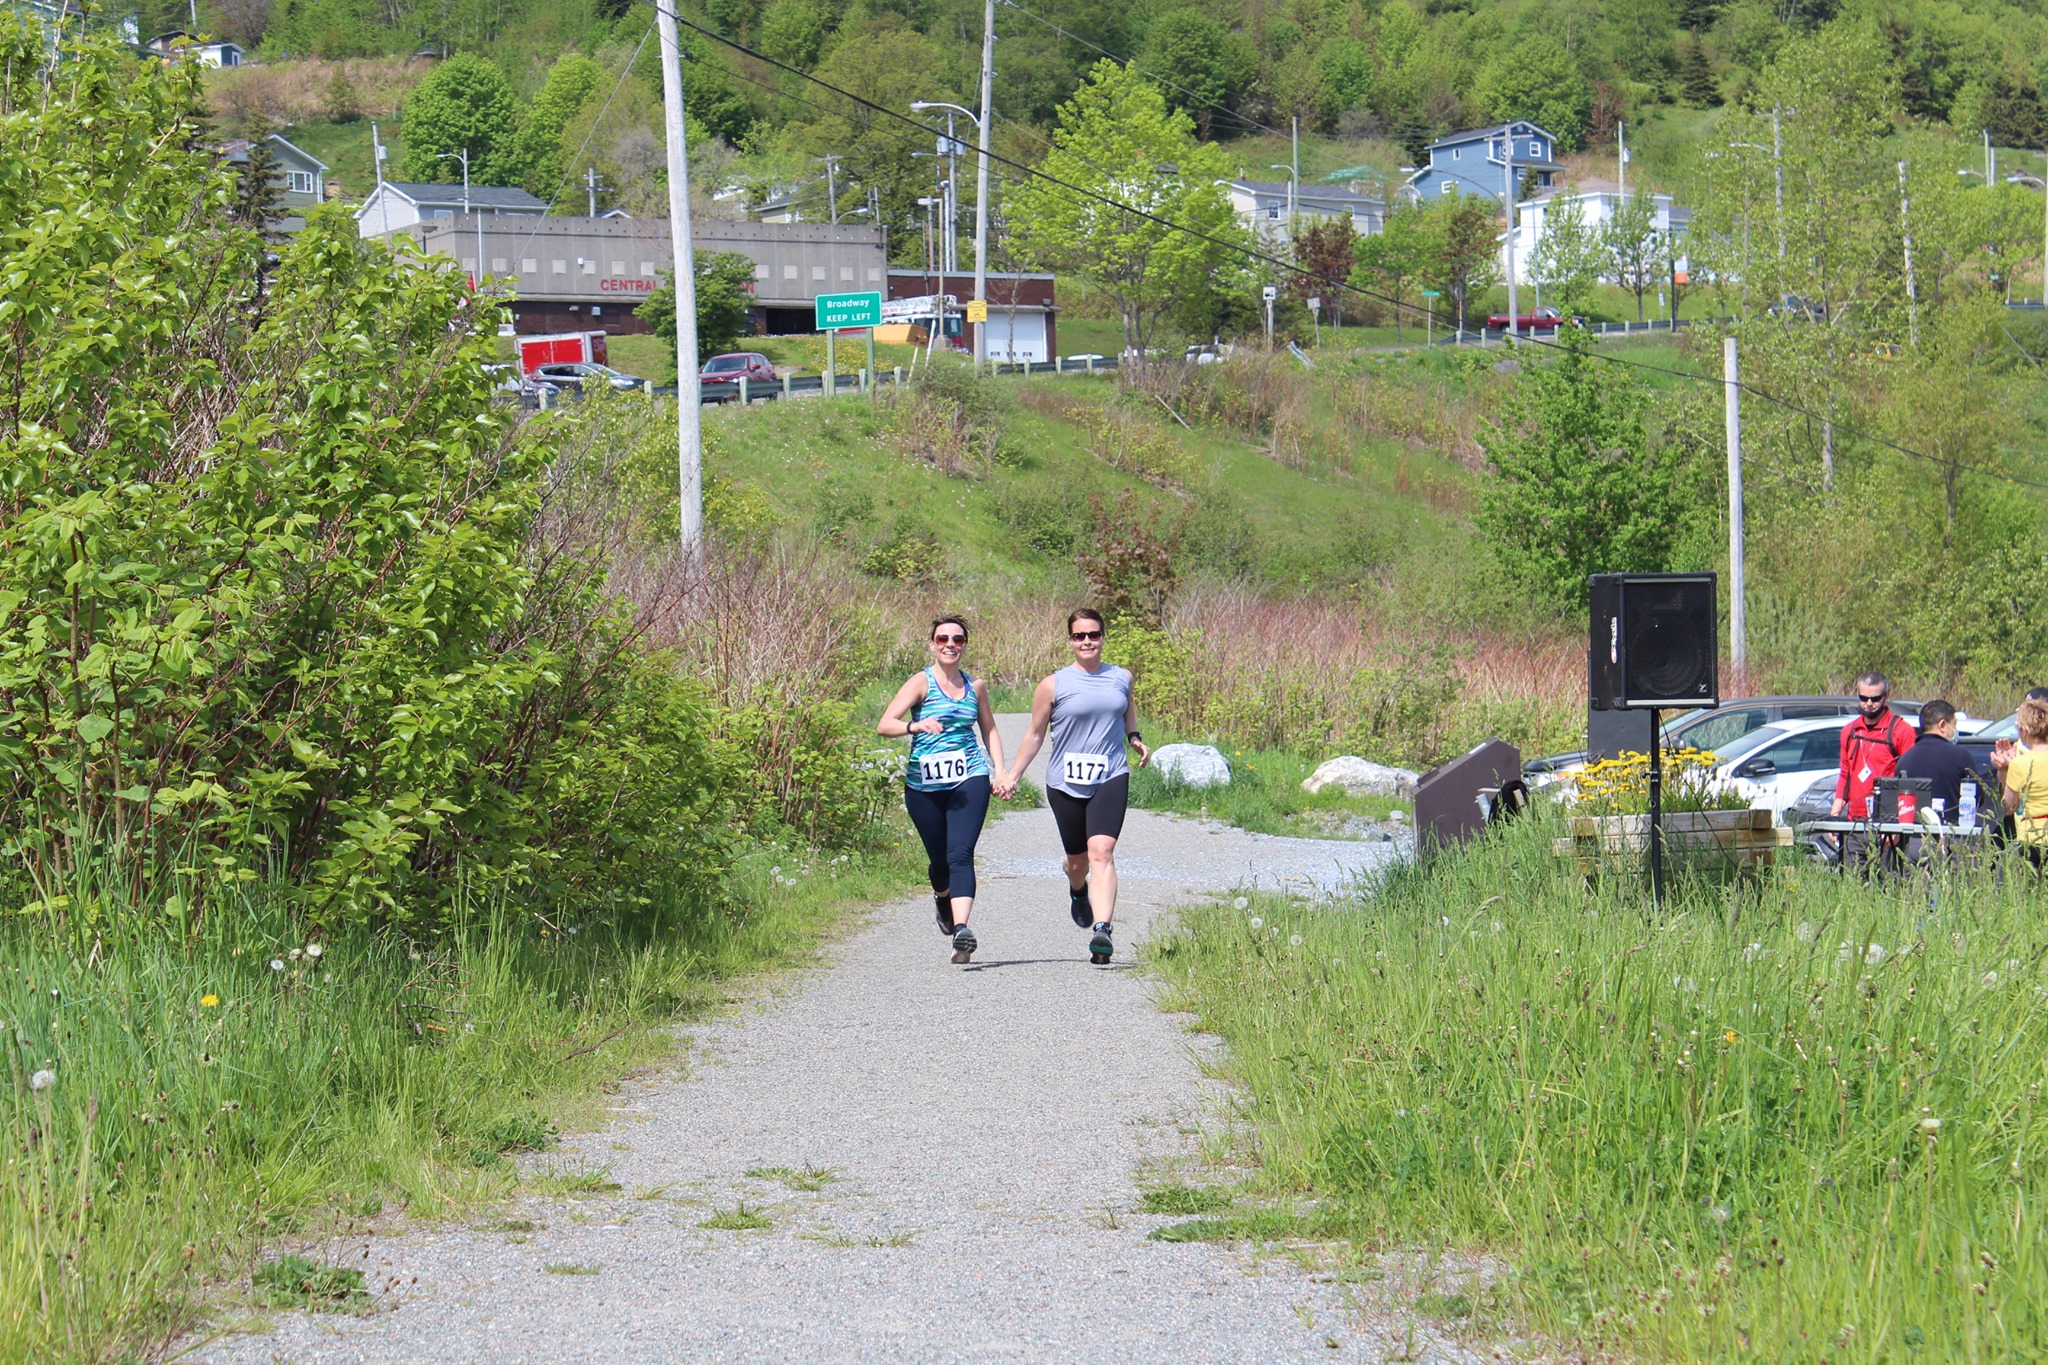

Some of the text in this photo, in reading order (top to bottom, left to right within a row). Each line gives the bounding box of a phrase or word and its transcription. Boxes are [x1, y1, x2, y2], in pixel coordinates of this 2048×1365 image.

[826, 299, 870, 309] Broadway
[826, 312, 871, 323] KEEP LEFT
[923, 758, 965, 780] 1176
[1066, 760, 1106, 781] 1177
